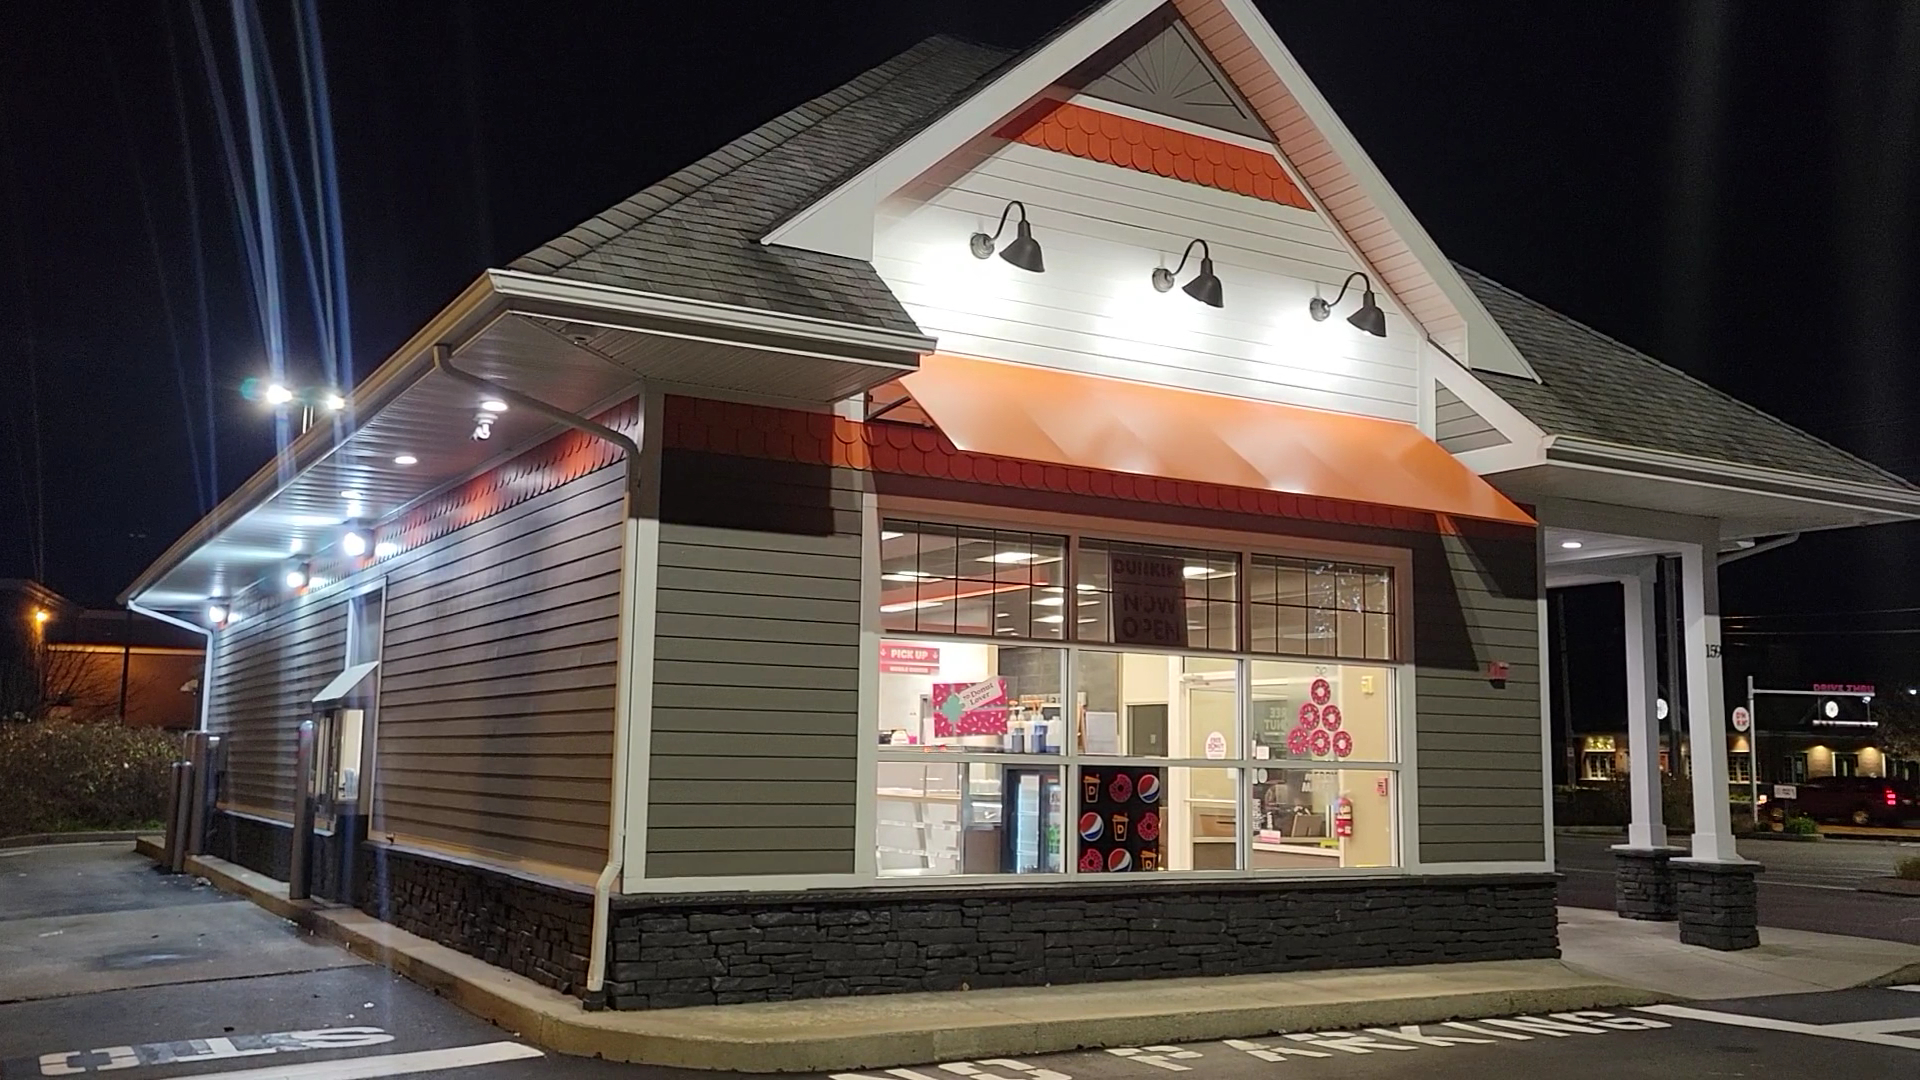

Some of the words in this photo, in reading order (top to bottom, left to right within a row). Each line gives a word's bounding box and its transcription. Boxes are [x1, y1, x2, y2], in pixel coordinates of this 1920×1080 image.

[1123, 592, 1175, 614] NOW
[1122, 616, 1180, 642] OPEN
[890, 648, 914, 659] PICK
[915, 649, 929, 660] UP
[1706, 643, 1722, 658] 159
[970, 682, 994, 698] Donut
[1813, 684, 1843, 692] DRIVE
[1847, 684, 1875, 692] THRU
[969, 692, 990, 705] Lover
[1088, 786, 1096, 796] D
[1117, 824, 1125, 834] D
[1145, 860, 1153, 869] D
[1104, 1010, 1673, 1072] PARKING
